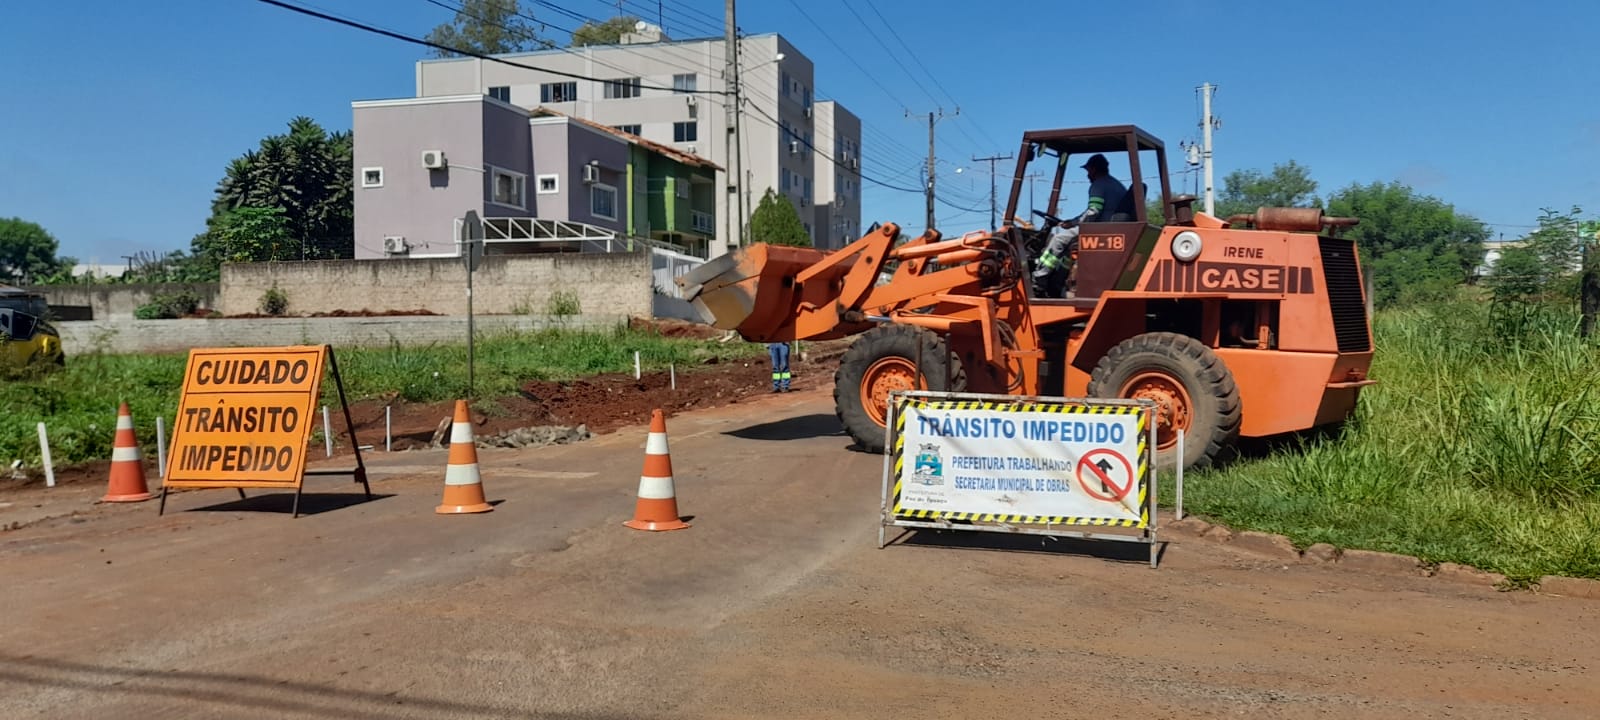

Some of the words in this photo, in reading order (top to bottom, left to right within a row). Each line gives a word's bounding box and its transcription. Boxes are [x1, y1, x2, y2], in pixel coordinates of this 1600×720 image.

[1081, 235, 1124, 249] W-18
[1223, 246, 1264, 259] IRENE
[1201, 268, 1281, 290] CASE
[197, 360, 308, 385] CUIDADO
[185, 399, 298, 433] TRÂNSITO
[917, 413, 1016, 438] TRÂNSITO
[1023, 420, 1125, 444] IMPEDIDO
[179, 445, 293, 472] IMPEDIDO
[952, 455, 1005, 470] PREFEITURA
[1006, 457, 1072, 473] TRABALHANDO
[954, 476, 997, 491] SECRETARIA
[997, 478, 1033, 492] MUNICIPAL
[1035, 480, 1045, 492] DE
[1046, 480, 1070, 492] OBRAS
